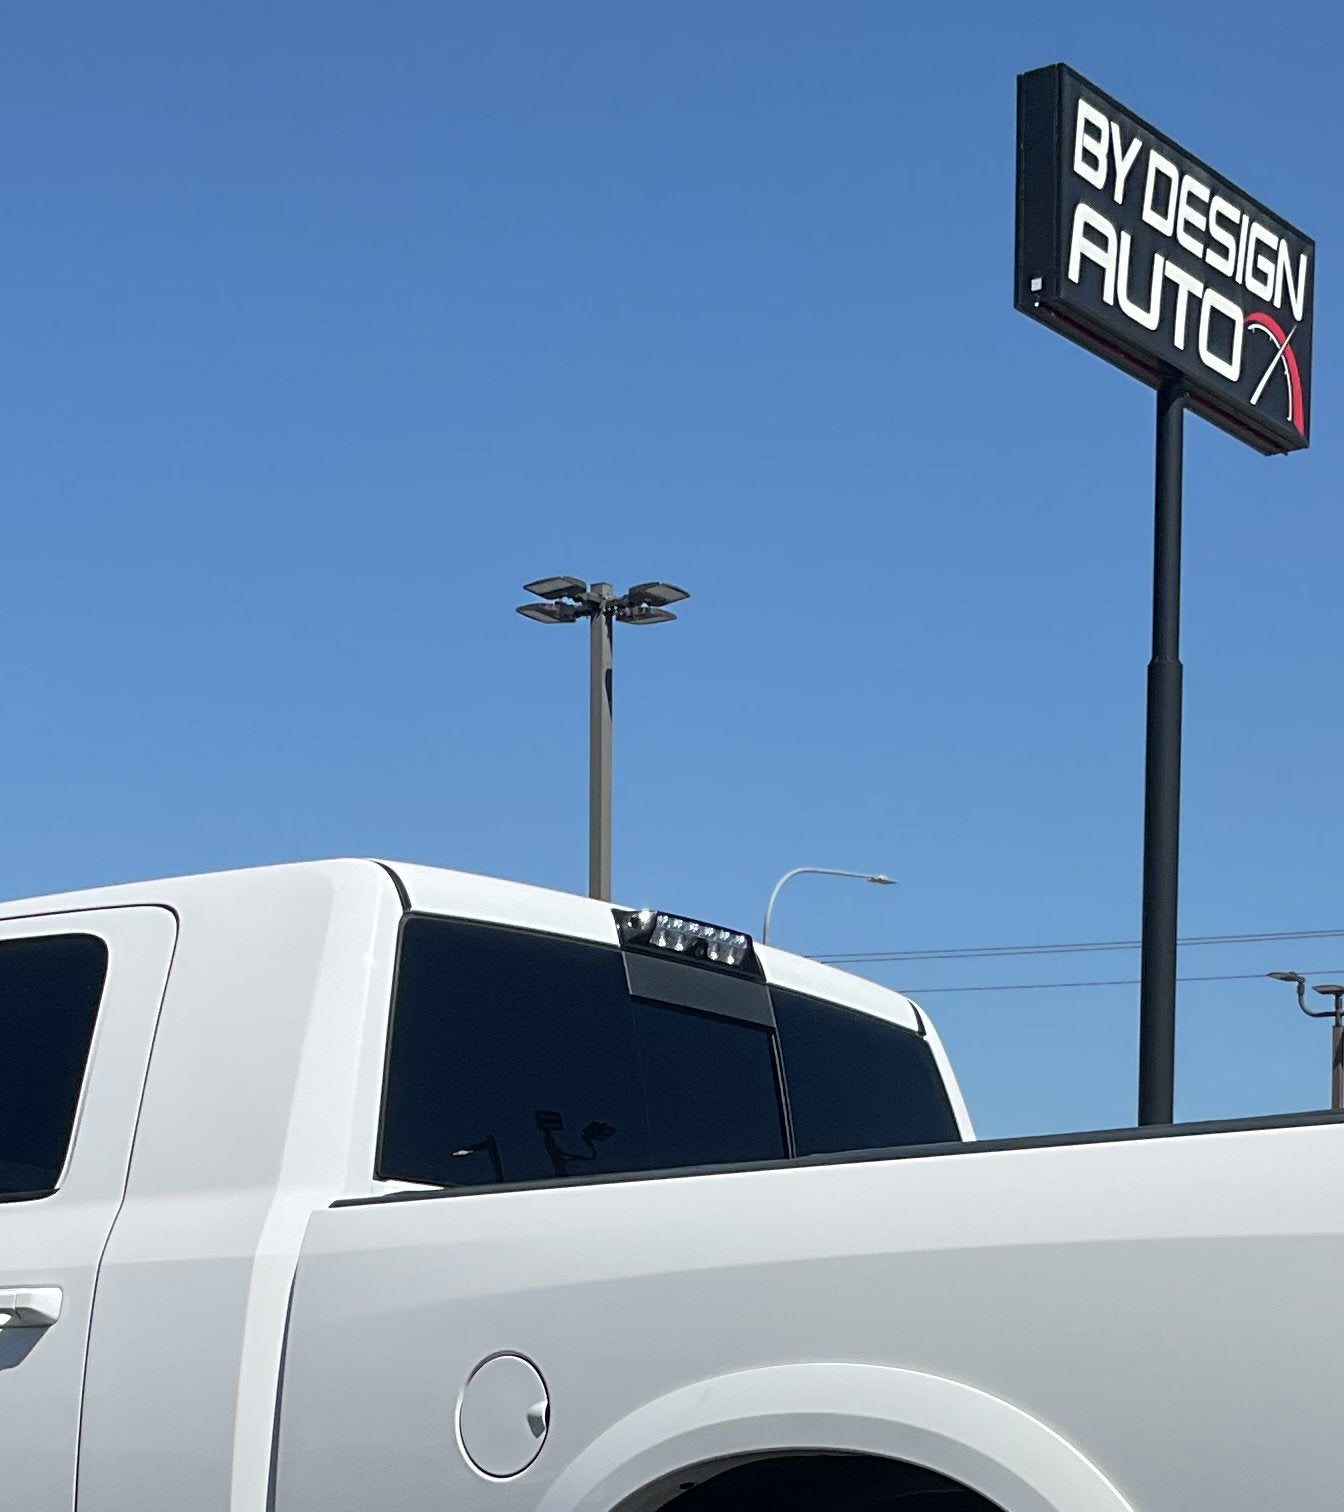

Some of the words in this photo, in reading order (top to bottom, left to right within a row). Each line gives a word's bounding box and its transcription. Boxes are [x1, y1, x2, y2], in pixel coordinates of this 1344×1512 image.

[1067, 202, 1245, 383] AUTO
[1072, 97, 1143, 205] BY
[1142, 148, 1308, 322] DESIGN
